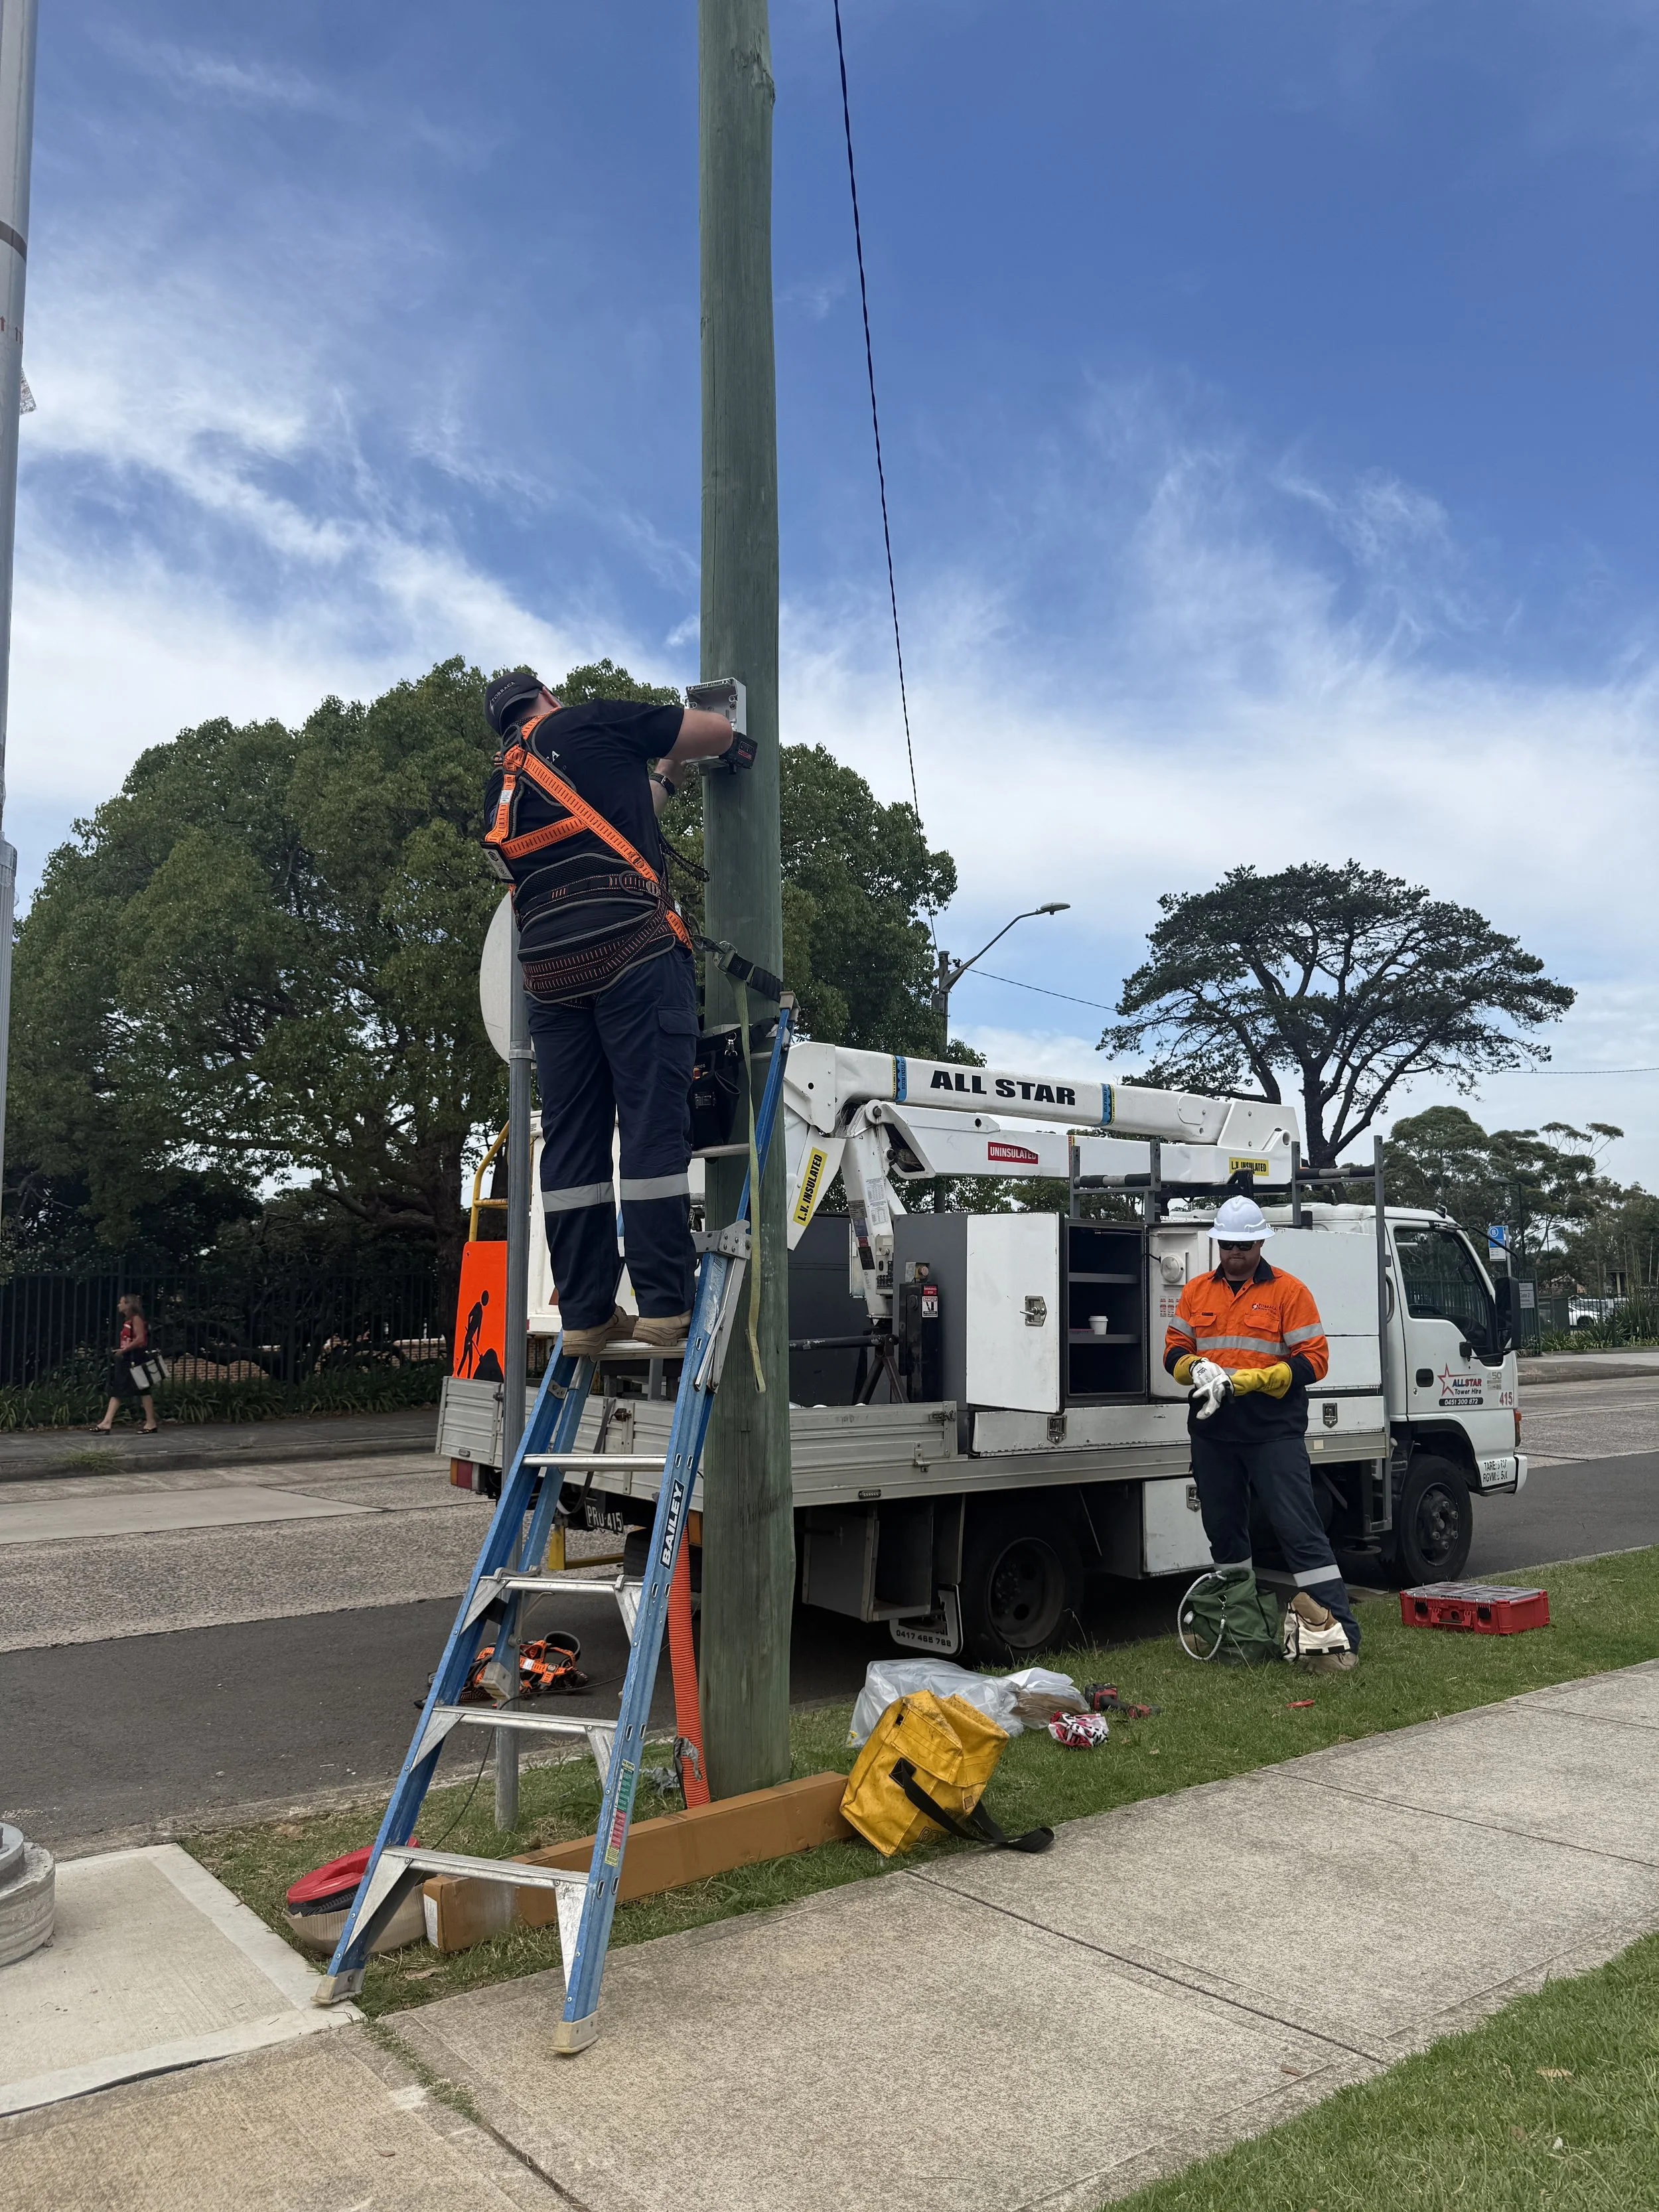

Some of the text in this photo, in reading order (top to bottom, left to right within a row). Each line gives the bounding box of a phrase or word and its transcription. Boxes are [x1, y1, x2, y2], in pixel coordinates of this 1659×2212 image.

[930, 1070, 1076, 1106] ALL STAR
[990, 1146, 1037, 1160] UNINSULATED
[1231, 1161, 1267, 1172] L.V INSULATED
[797, 1153, 823, 1222] L.V. INSULATED
[1499, 1391, 1513, 1406] 415
[662, 1482, 682, 1566] BAILEY
[896, 1629, 916, 1639] 0417
